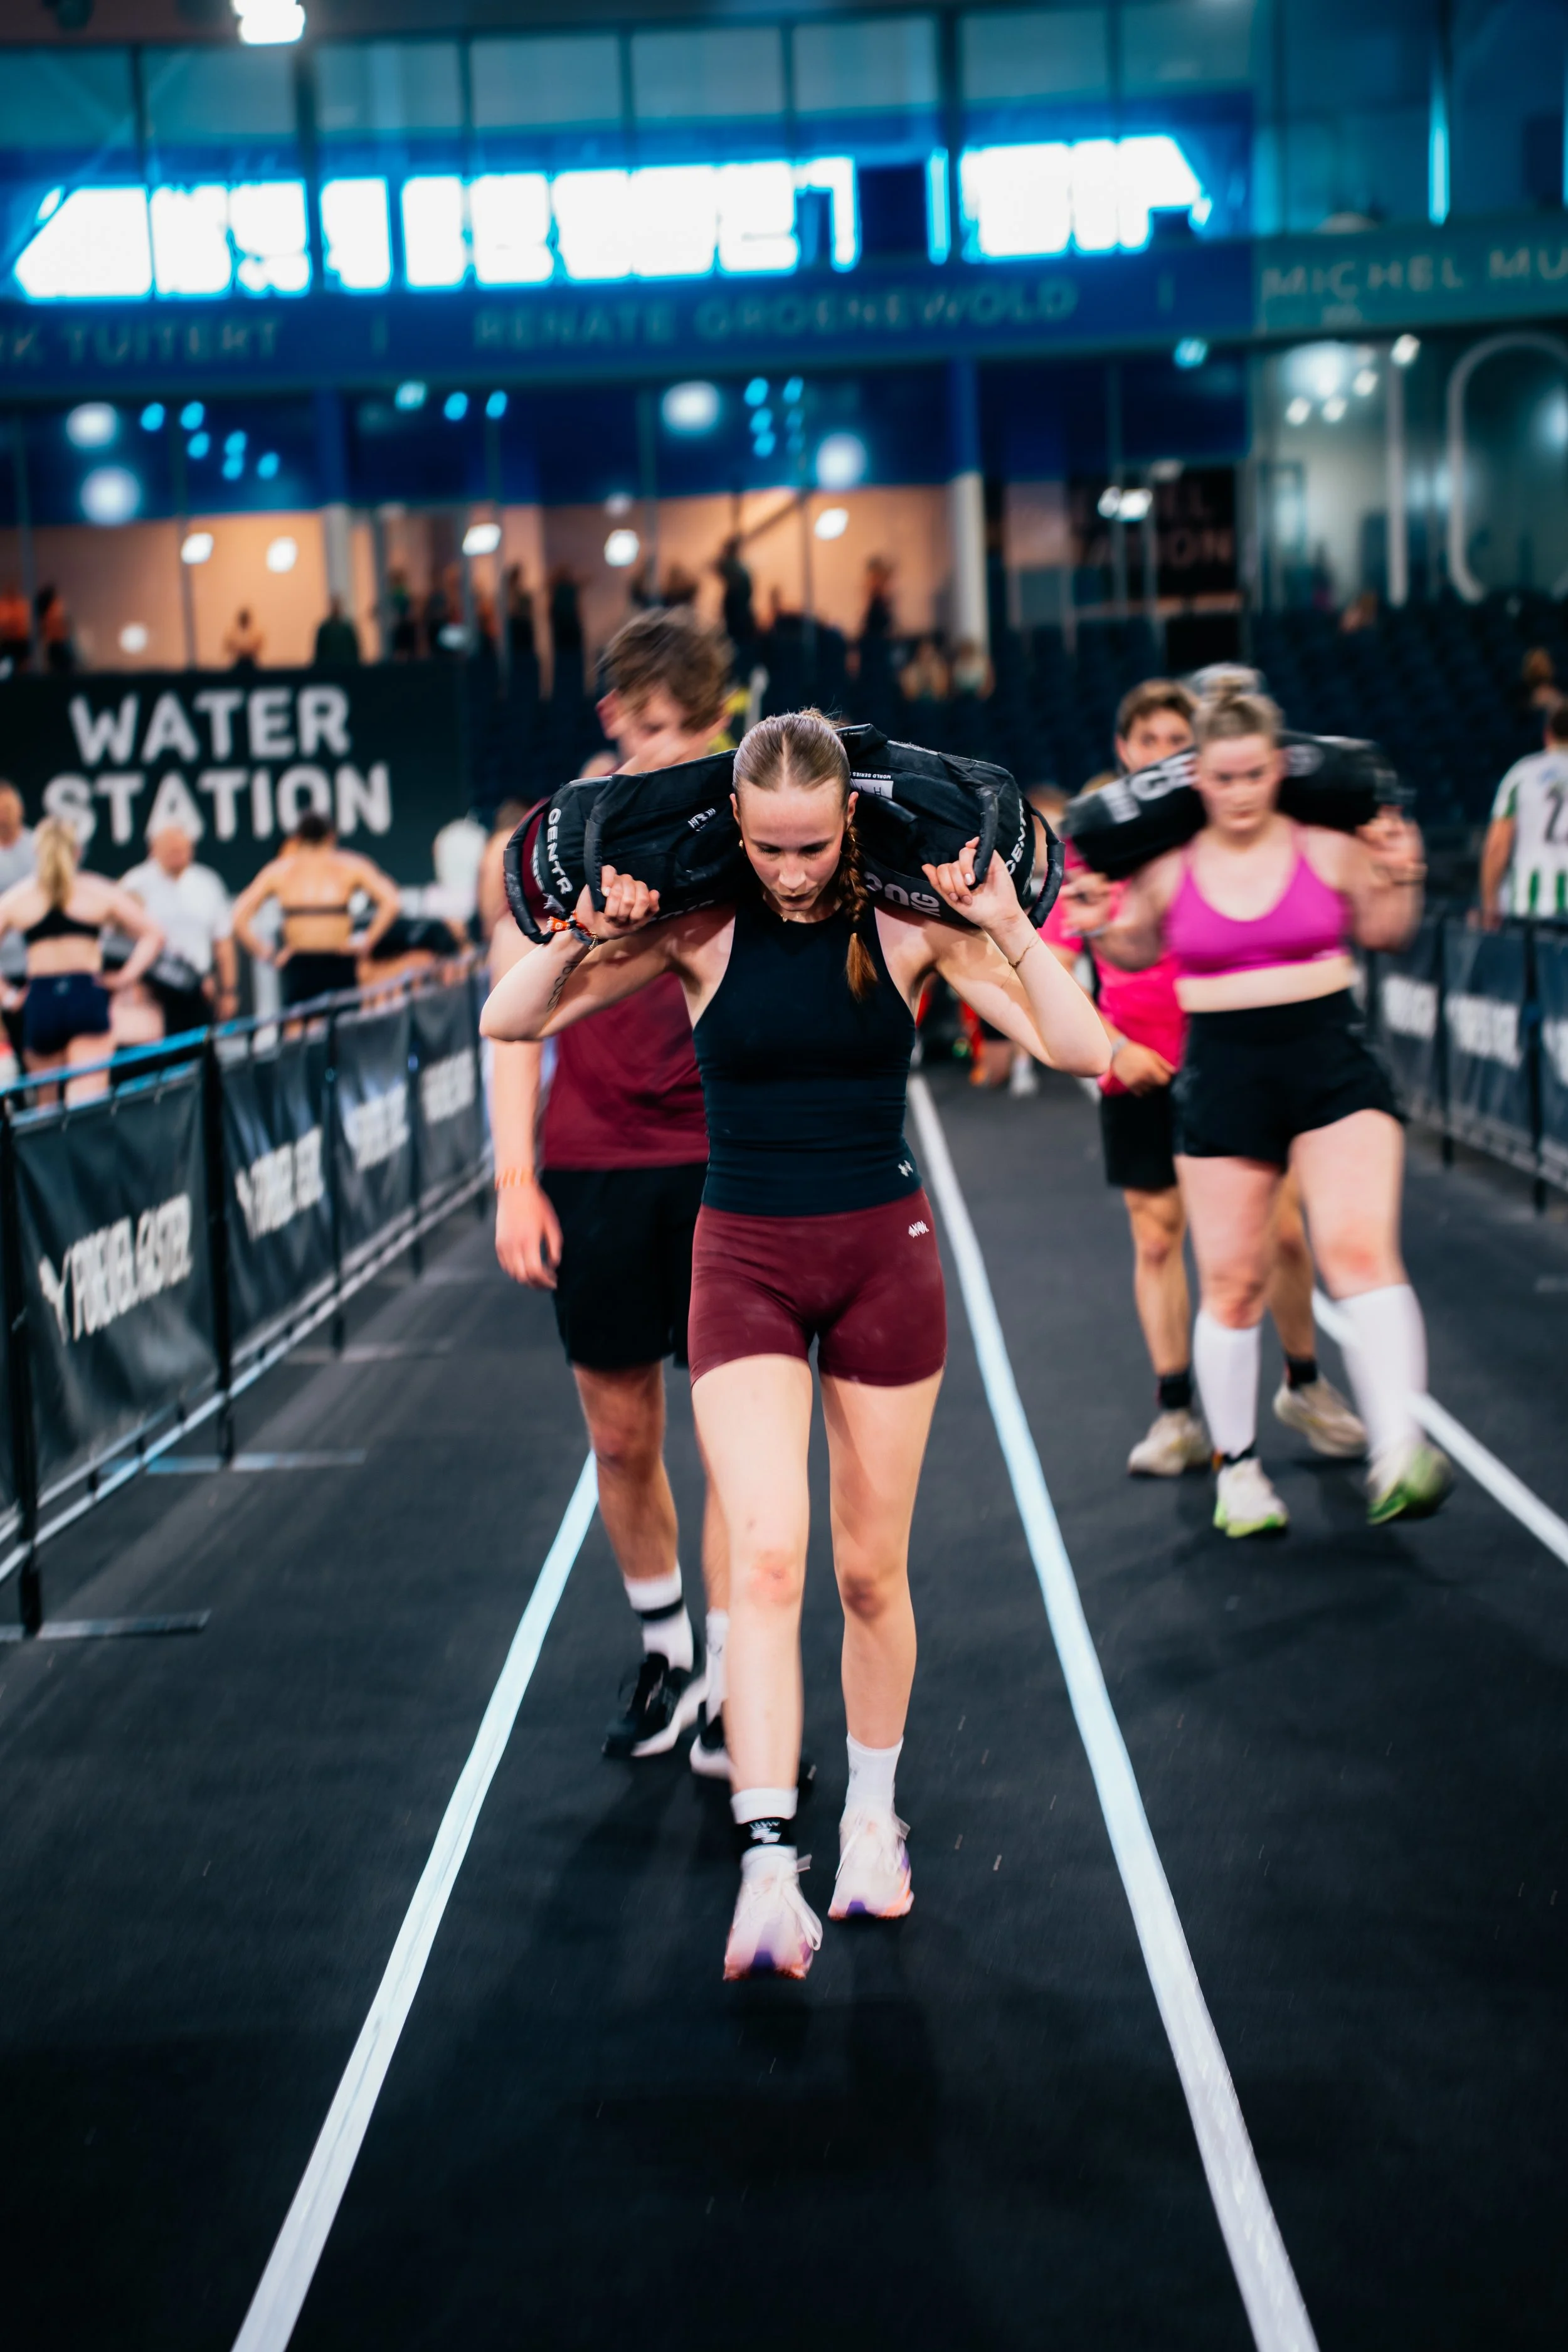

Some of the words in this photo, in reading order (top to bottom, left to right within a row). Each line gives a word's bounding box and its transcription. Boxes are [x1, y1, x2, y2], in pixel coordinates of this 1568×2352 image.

[1261, 254, 1464, 301] MICHEL
[70, 686, 350, 765] WATER
[45, 762, 391, 844] STATION
[547, 807, 573, 894] CENTR
